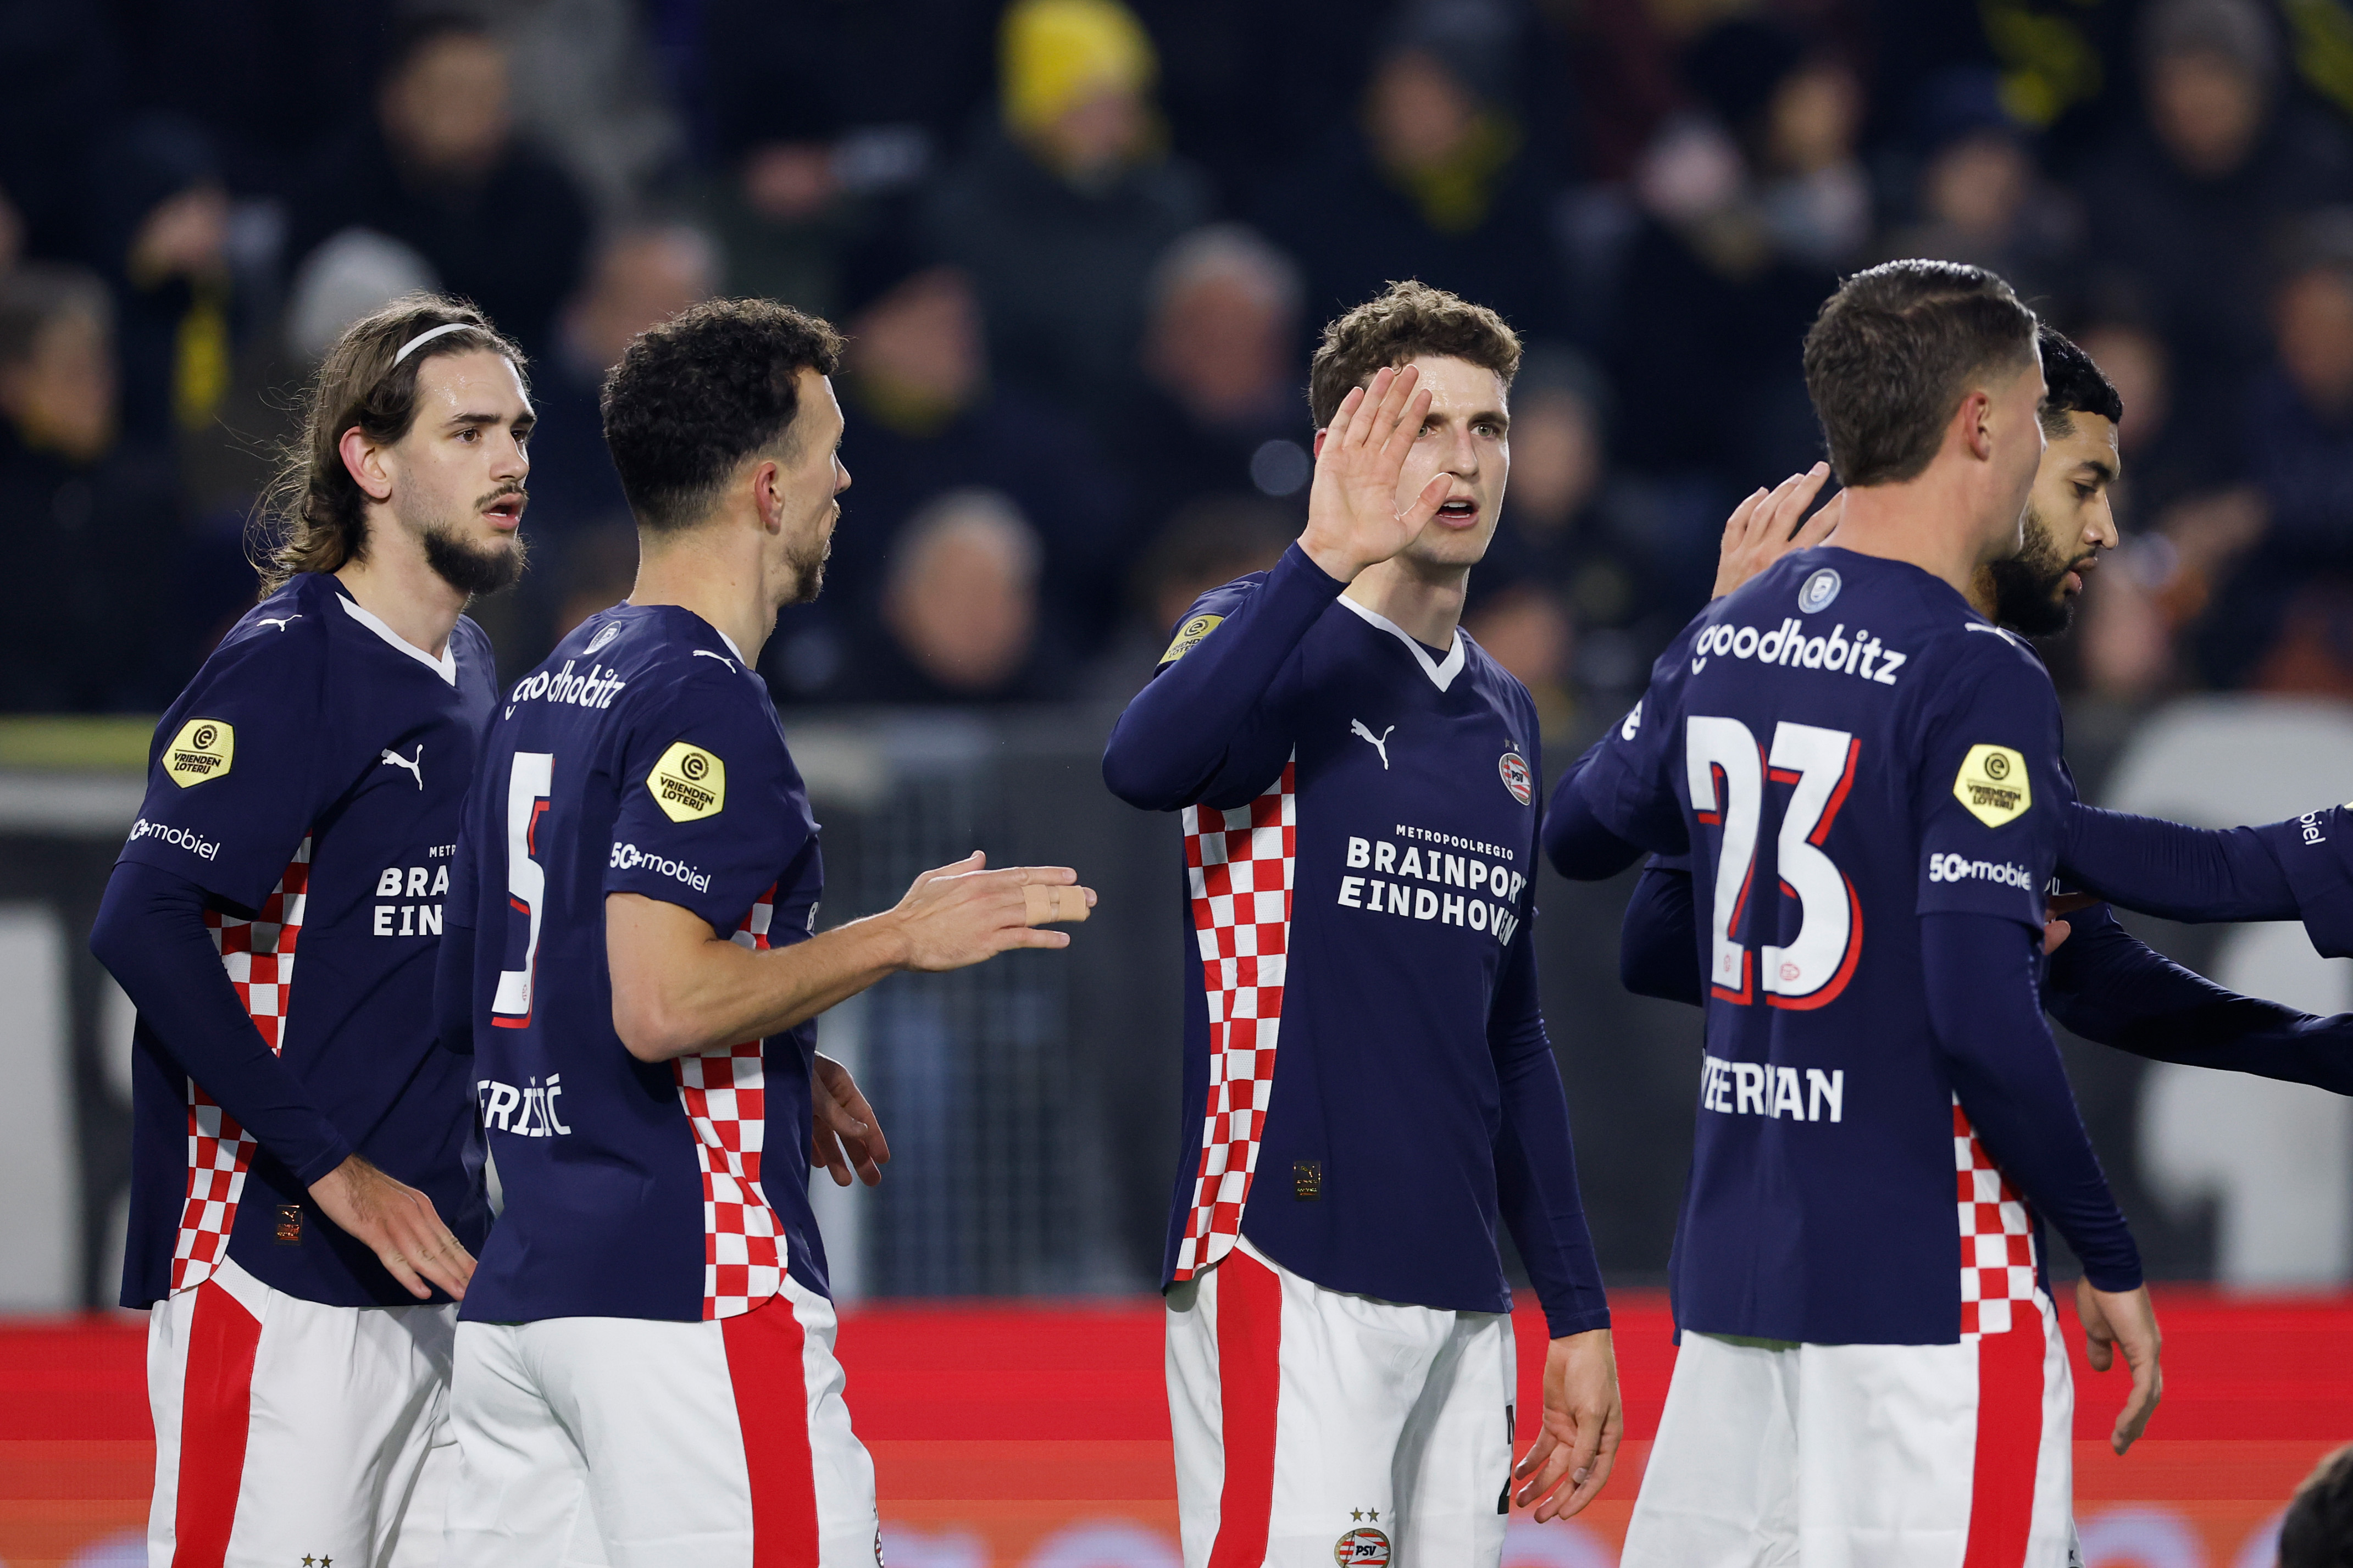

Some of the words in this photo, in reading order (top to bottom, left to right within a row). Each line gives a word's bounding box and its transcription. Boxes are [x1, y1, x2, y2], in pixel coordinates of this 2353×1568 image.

[174, 752, 221, 768] VRIENDEN
[174, 762, 211, 775] LOTERIJ
[660, 776, 715, 806] VRIENDEN
[1511, 770, 1523, 783] PSV
[662, 788, 704, 811] LOTERIJ
[1396, 824, 1514, 861] METROPOOLREGIO
[1686, 715, 1863, 1010] 23
[376, 865, 449, 897] BRA
[491, 752, 556, 1029] 5
[373, 904, 443, 936] EIN
[1355, 1545, 1377, 1556] PSV
